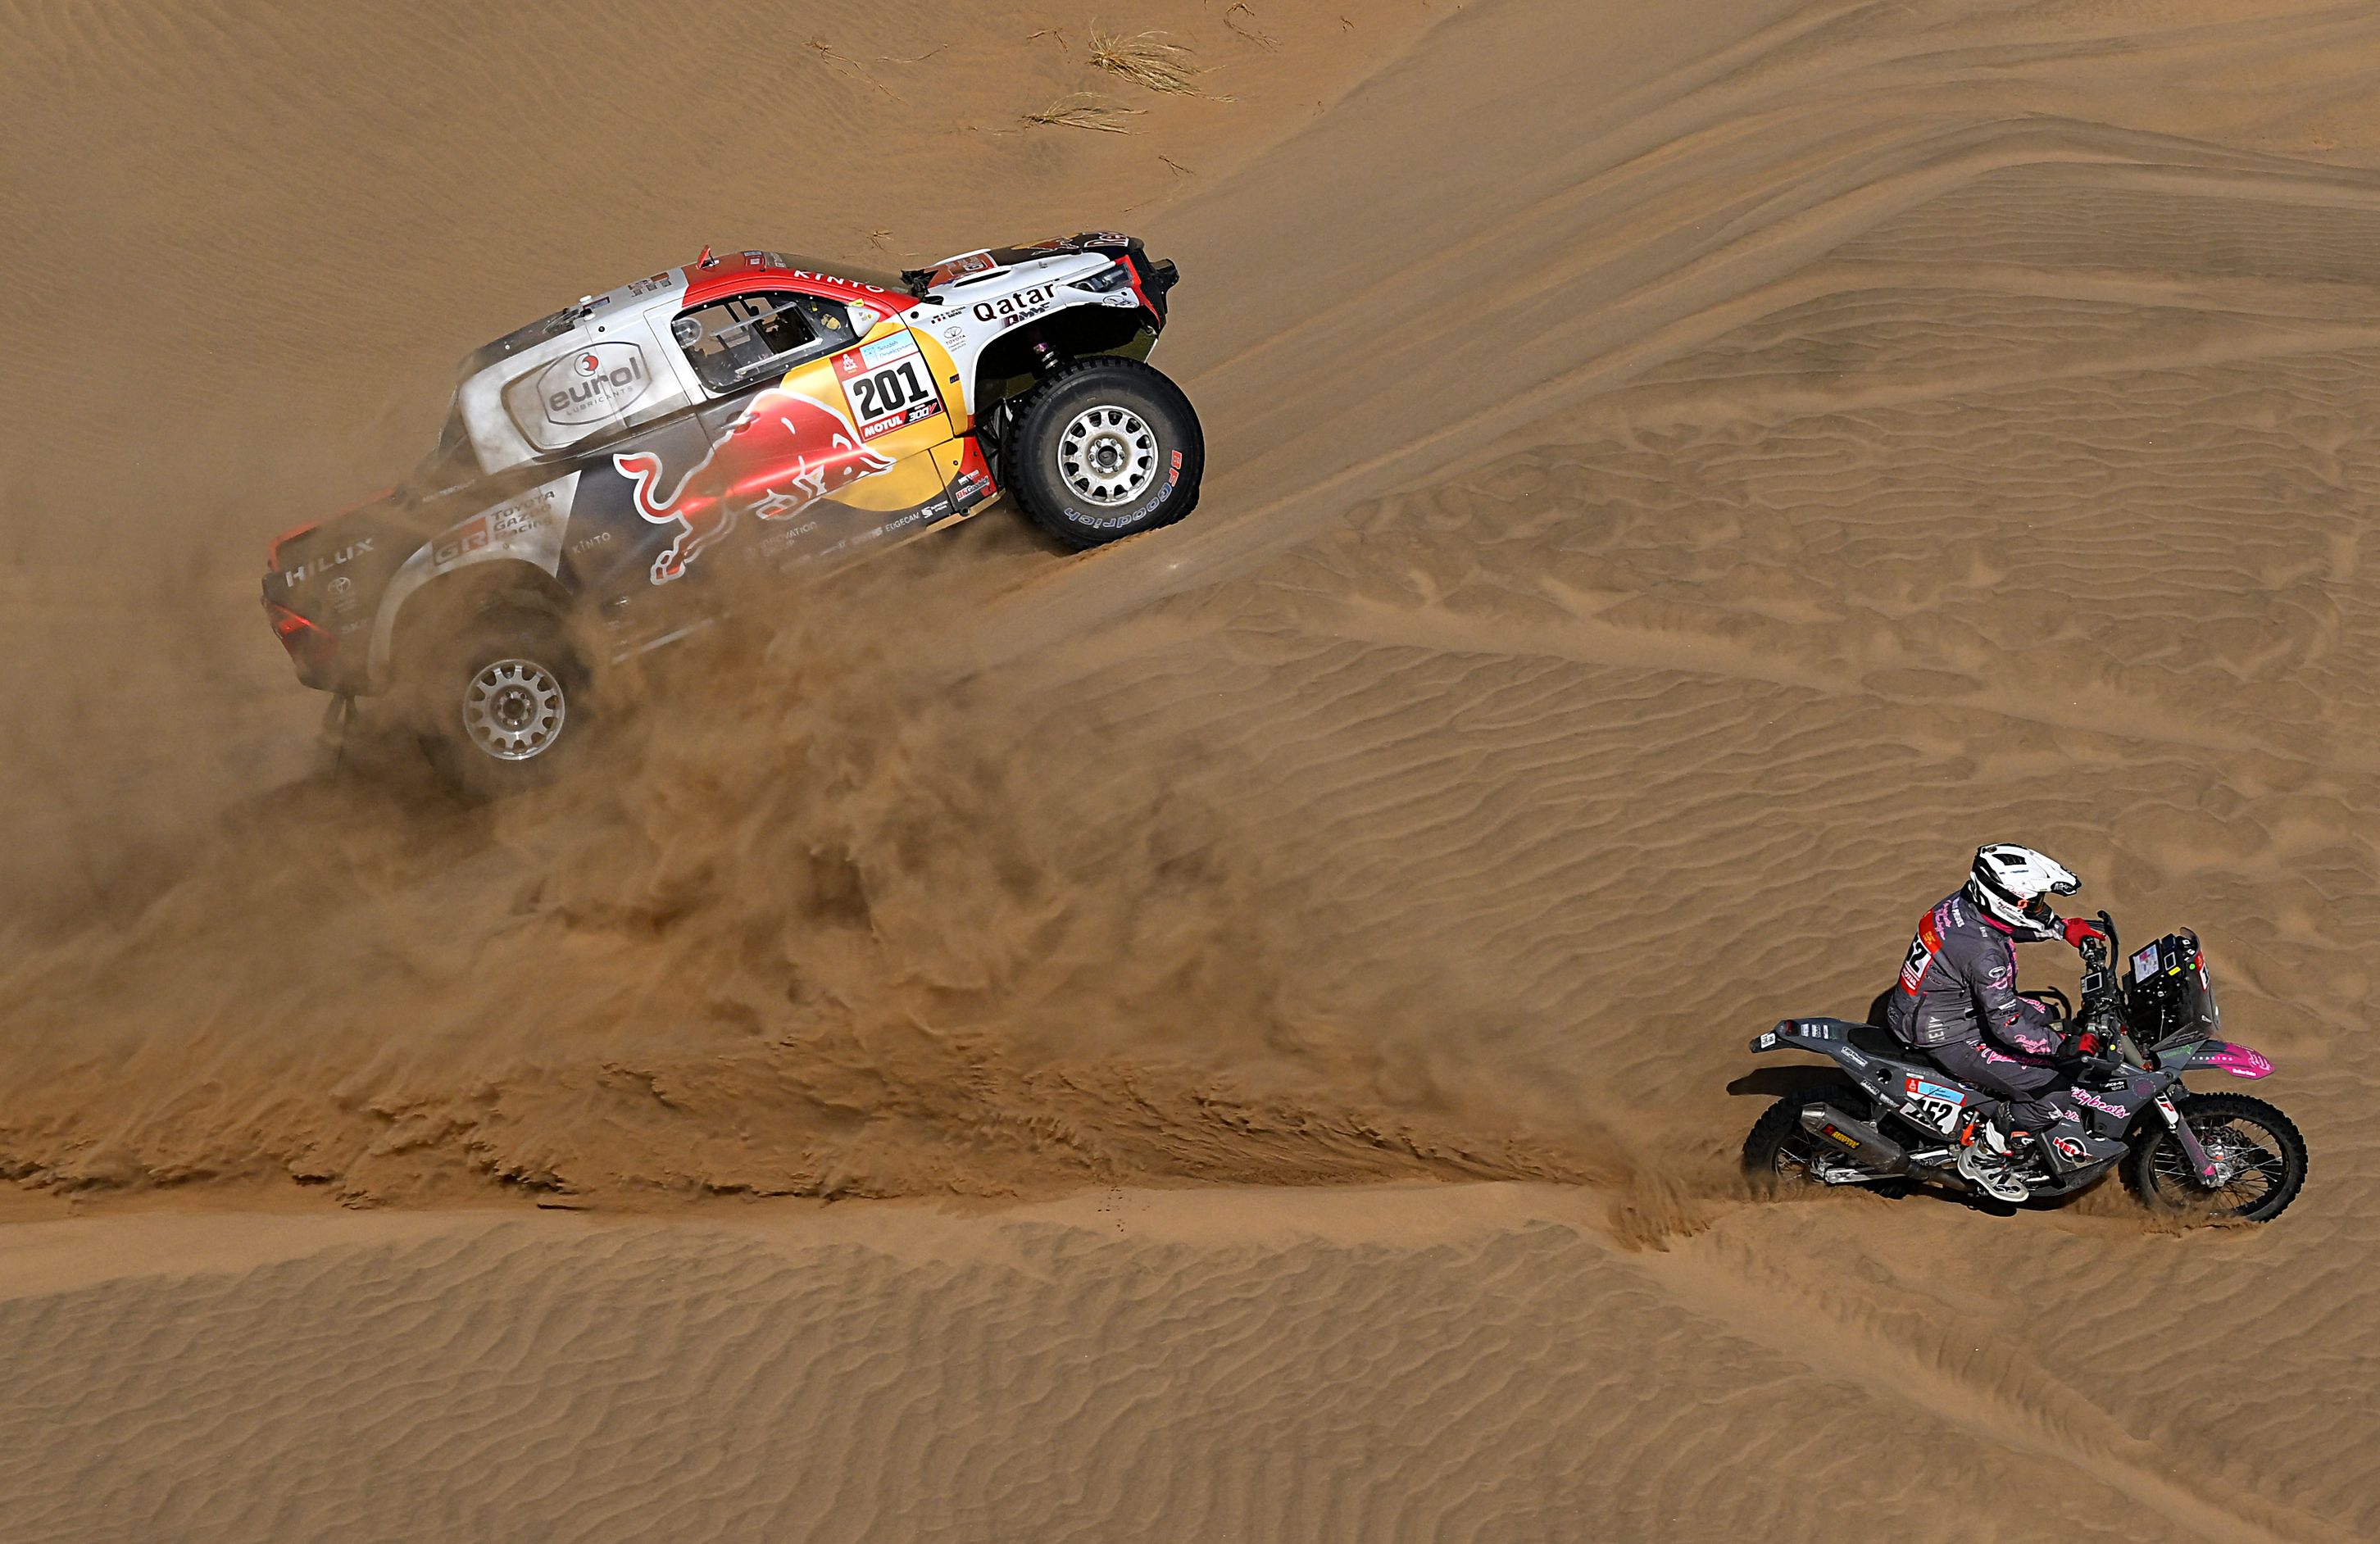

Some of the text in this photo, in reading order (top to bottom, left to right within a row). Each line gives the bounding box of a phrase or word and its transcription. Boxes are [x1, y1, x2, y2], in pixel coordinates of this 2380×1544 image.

[794, 270, 884, 293] KINTO
[973, 283, 1055, 322] Qatar
[945, 334, 966, 346] TOYOTA
[549, 356, 642, 411] eurol
[853, 361, 929, 420] 201
[566, 387, 634, 416] LUBRICANTS
[865, 416, 903, 438] MOTUL
[492, 491, 555, 520] TOYOTA
[574, 532, 611, 554] KINTO
[285, 538, 375, 588] HILUX
